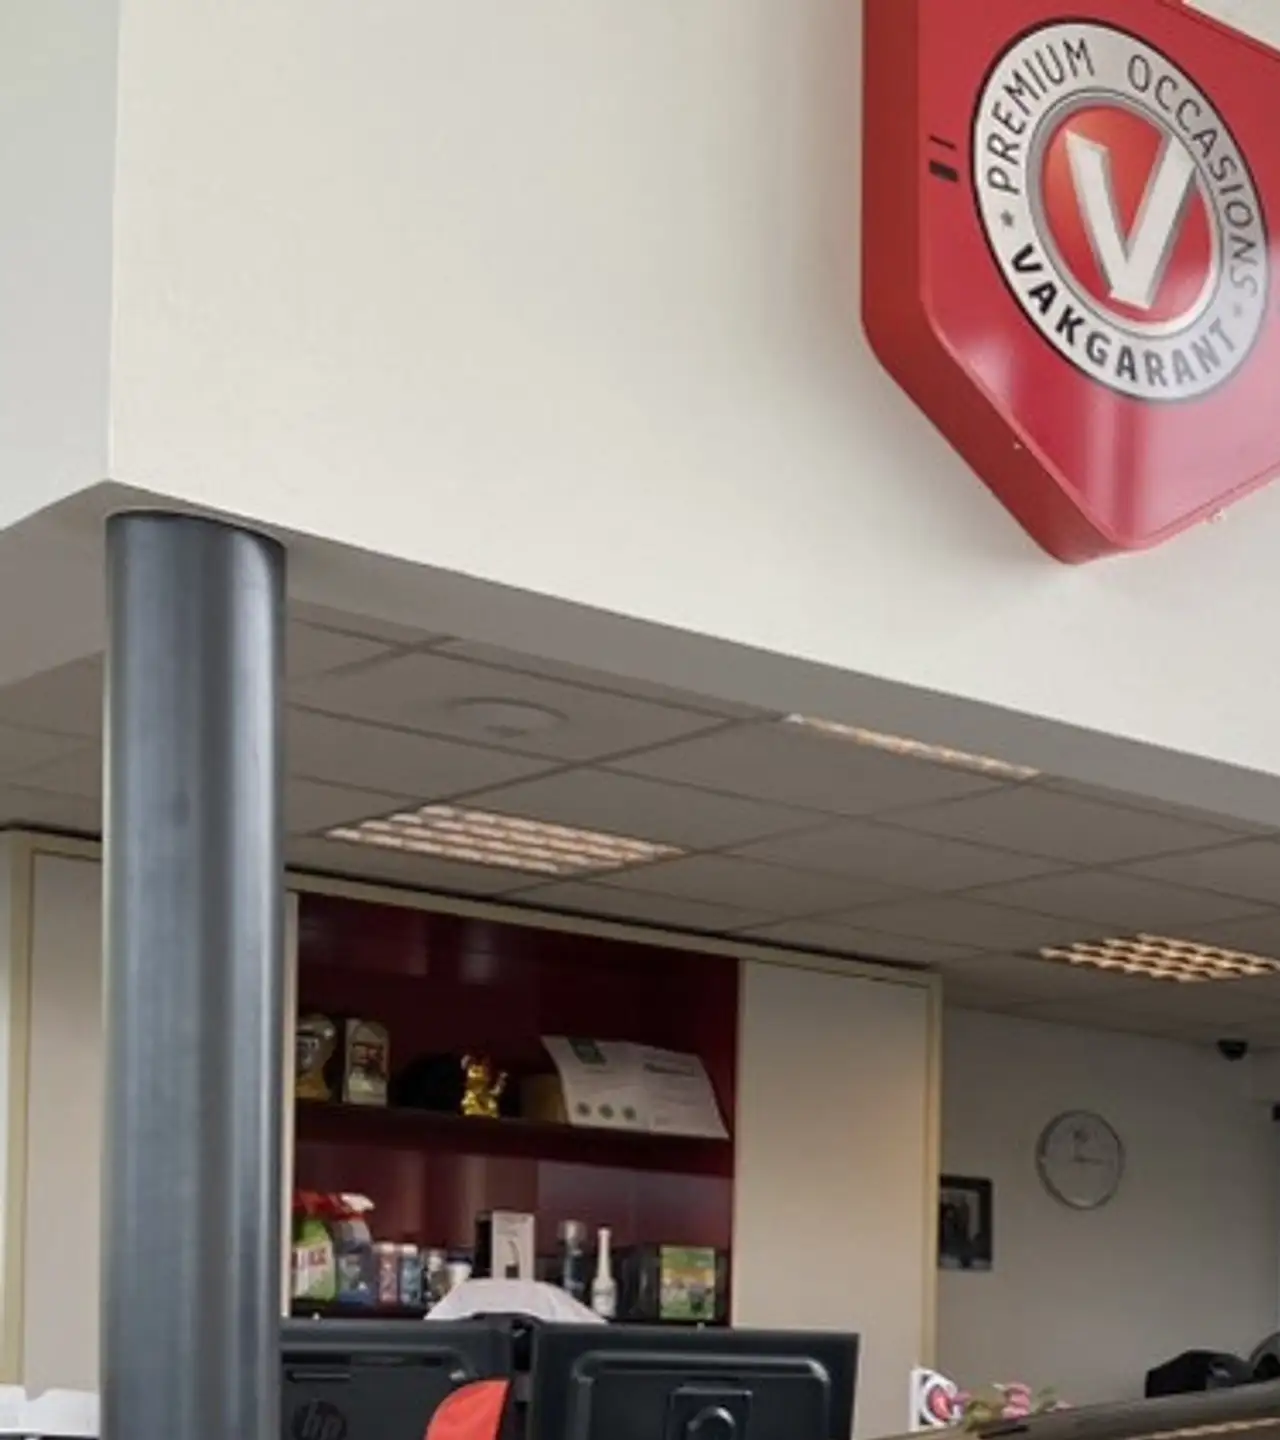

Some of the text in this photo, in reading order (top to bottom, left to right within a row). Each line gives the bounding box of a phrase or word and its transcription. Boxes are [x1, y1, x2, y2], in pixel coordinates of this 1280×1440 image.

[987, 37, 1260, 298] PREMIUM OCCASIONS
[1064, 127, 1204, 311] V
[1010, 243, 1237, 388] VAKGARANT
